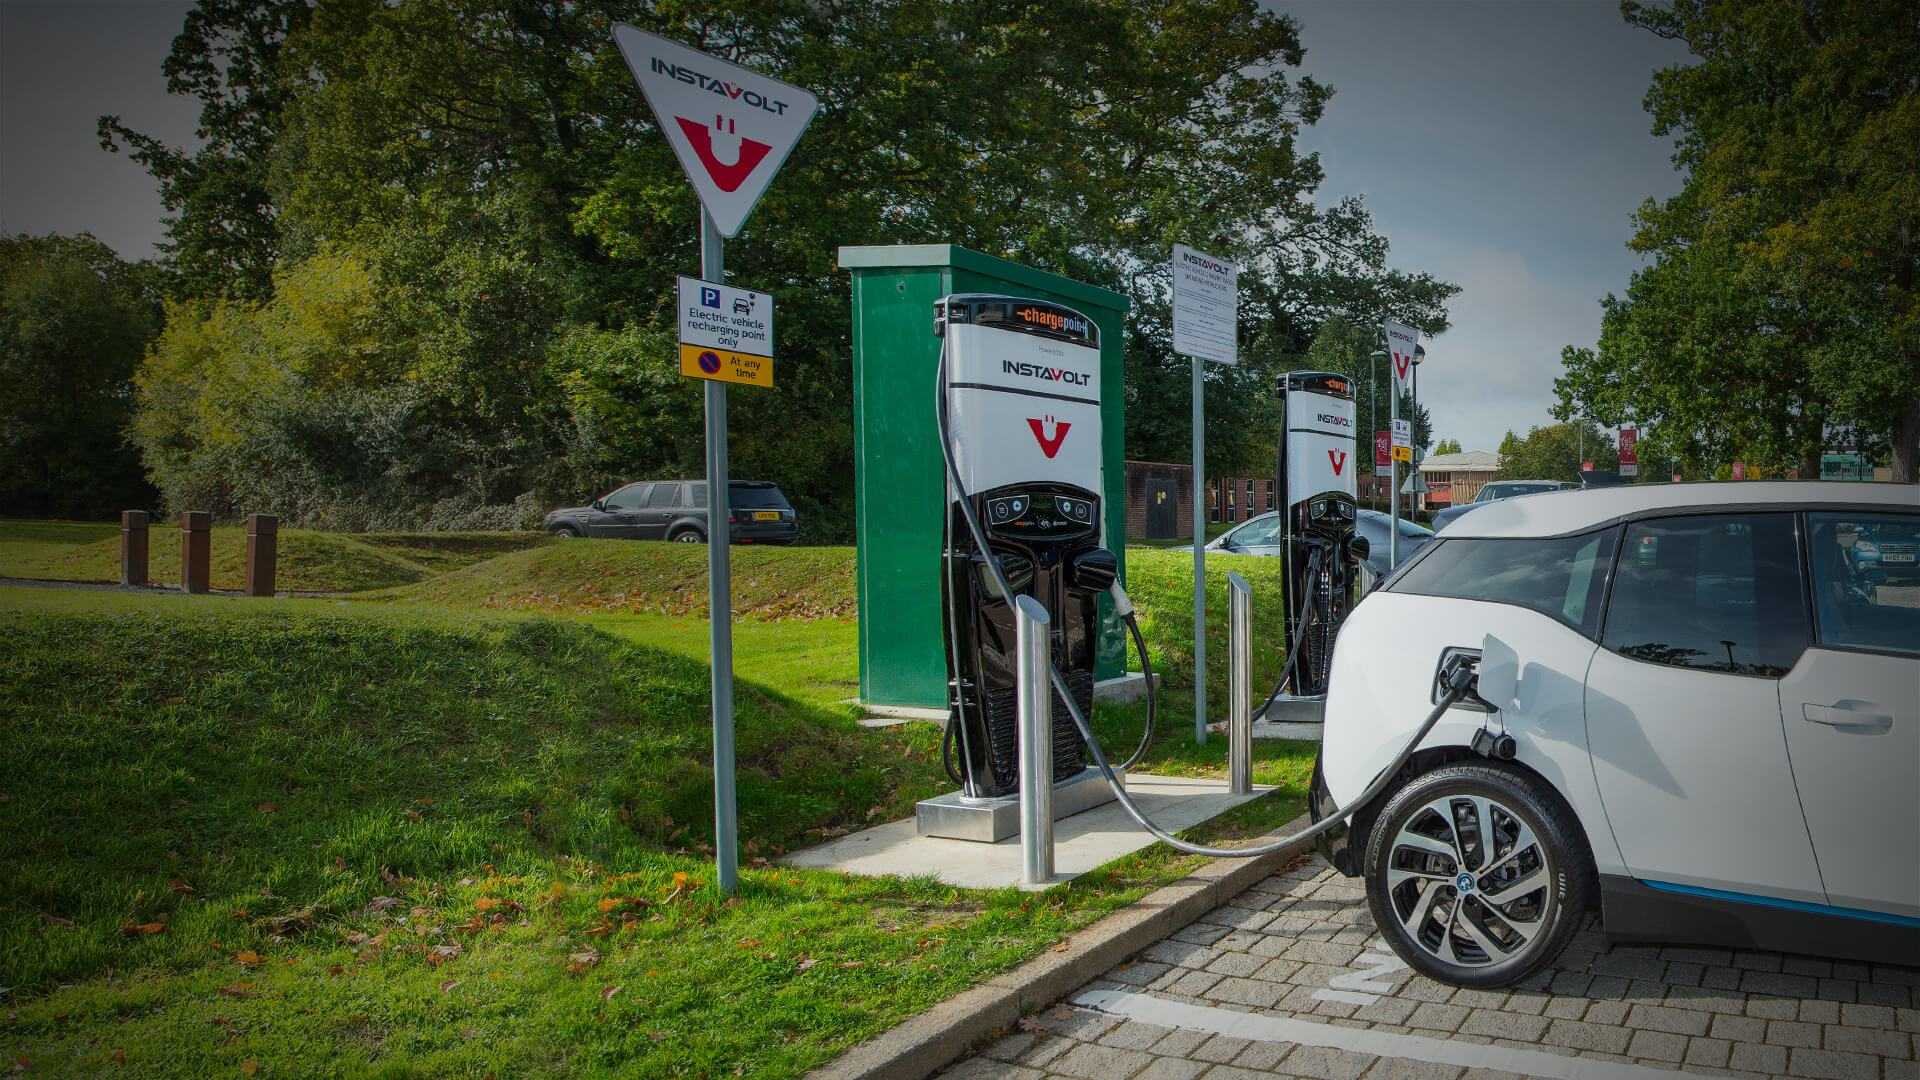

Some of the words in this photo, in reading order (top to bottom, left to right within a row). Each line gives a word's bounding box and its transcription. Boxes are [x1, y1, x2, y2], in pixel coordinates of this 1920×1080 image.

[651, 56, 788, 115] INSTAVOLT
[705, 290, 716, 305] P
[689, 307, 728, 323] Electric
[731, 317, 764, 330] vehicle
[688, 320, 739, 337] recharging
[742, 331, 766, 341] point
[718, 337, 738, 348] only
[730, 356, 741, 365] At
[744, 360, 761, 370] any
[736, 368, 757, 379] time
[1003, 359, 1091, 386] INSTAVOLT
